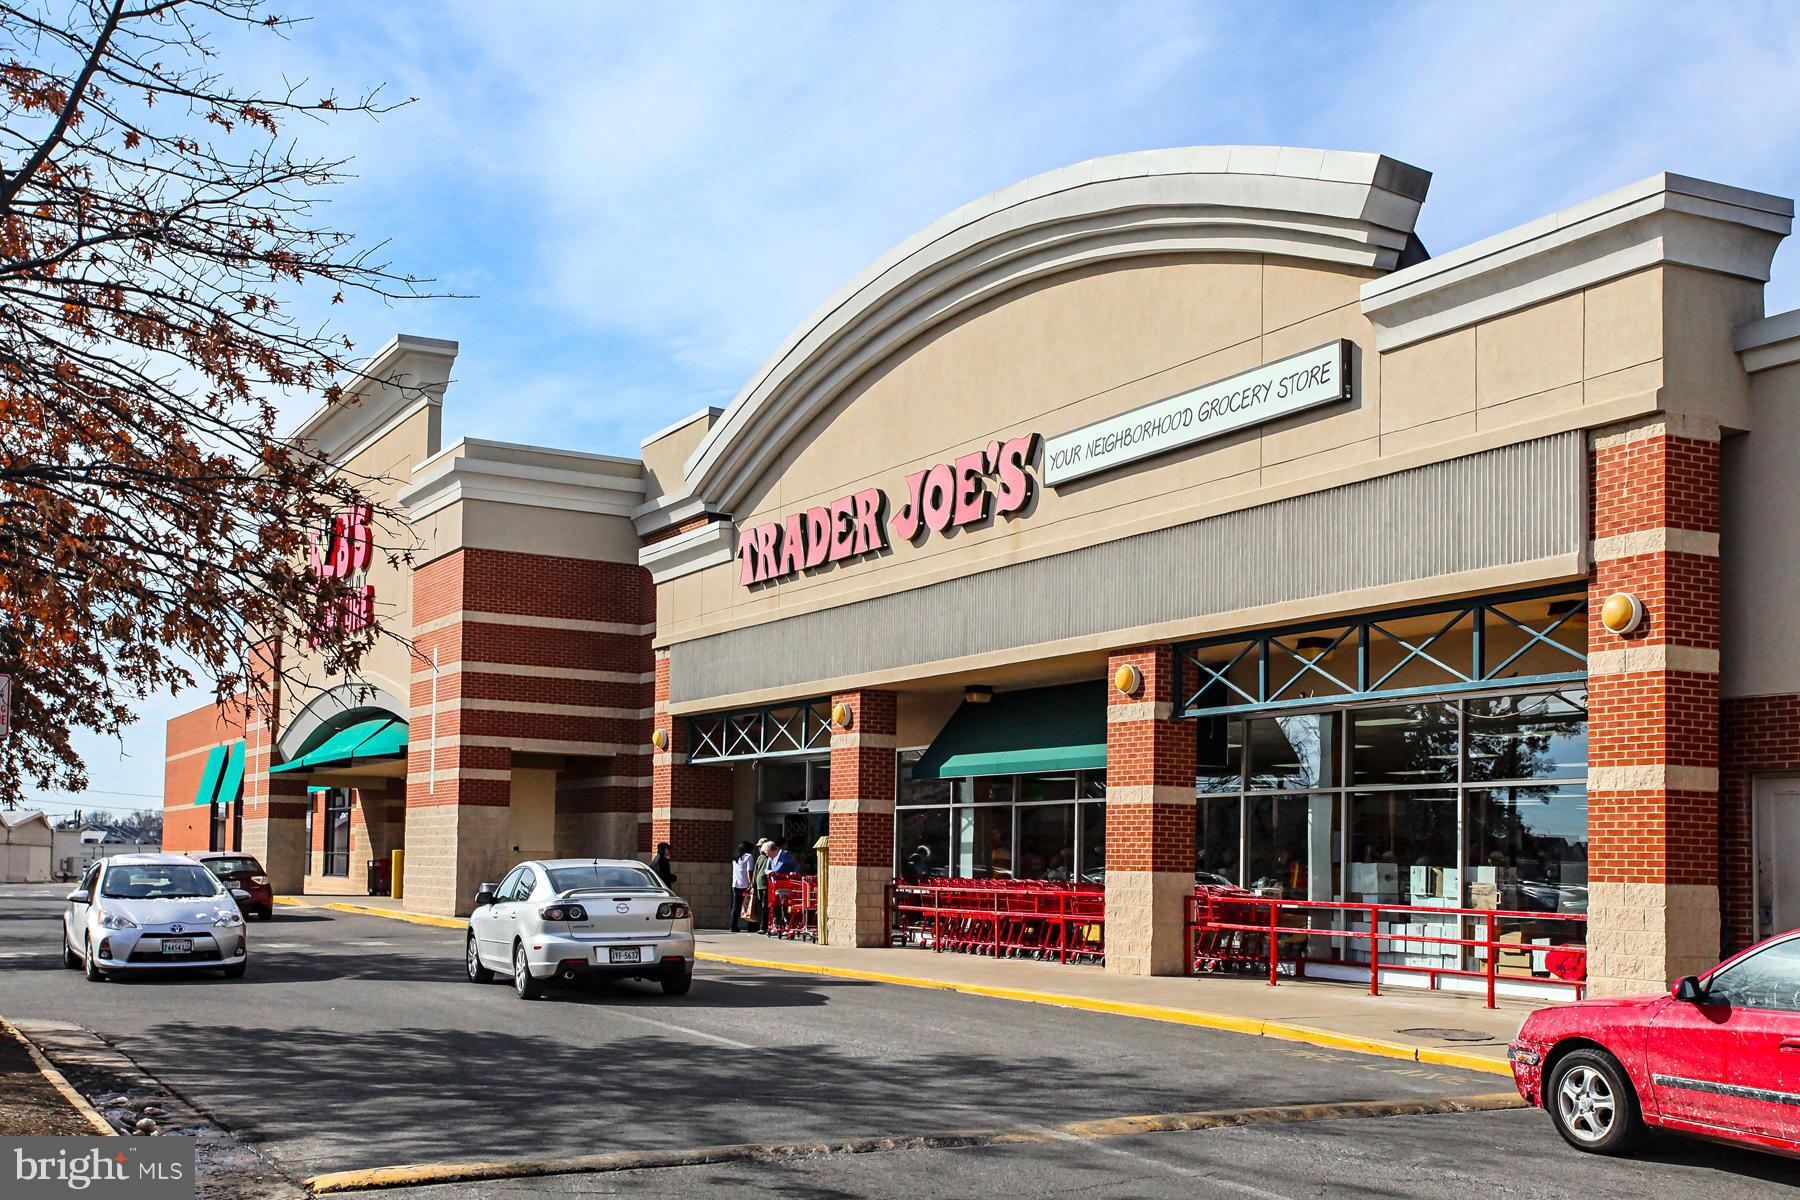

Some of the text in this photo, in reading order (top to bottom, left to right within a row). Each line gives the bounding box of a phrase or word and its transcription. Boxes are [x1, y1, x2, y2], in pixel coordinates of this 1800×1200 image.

[1049, 360, 1333, 472] YOUR NEIGHBORHOOD GROCERY STORE
[737, 432, 1043, 587] TRADER JOE'S
